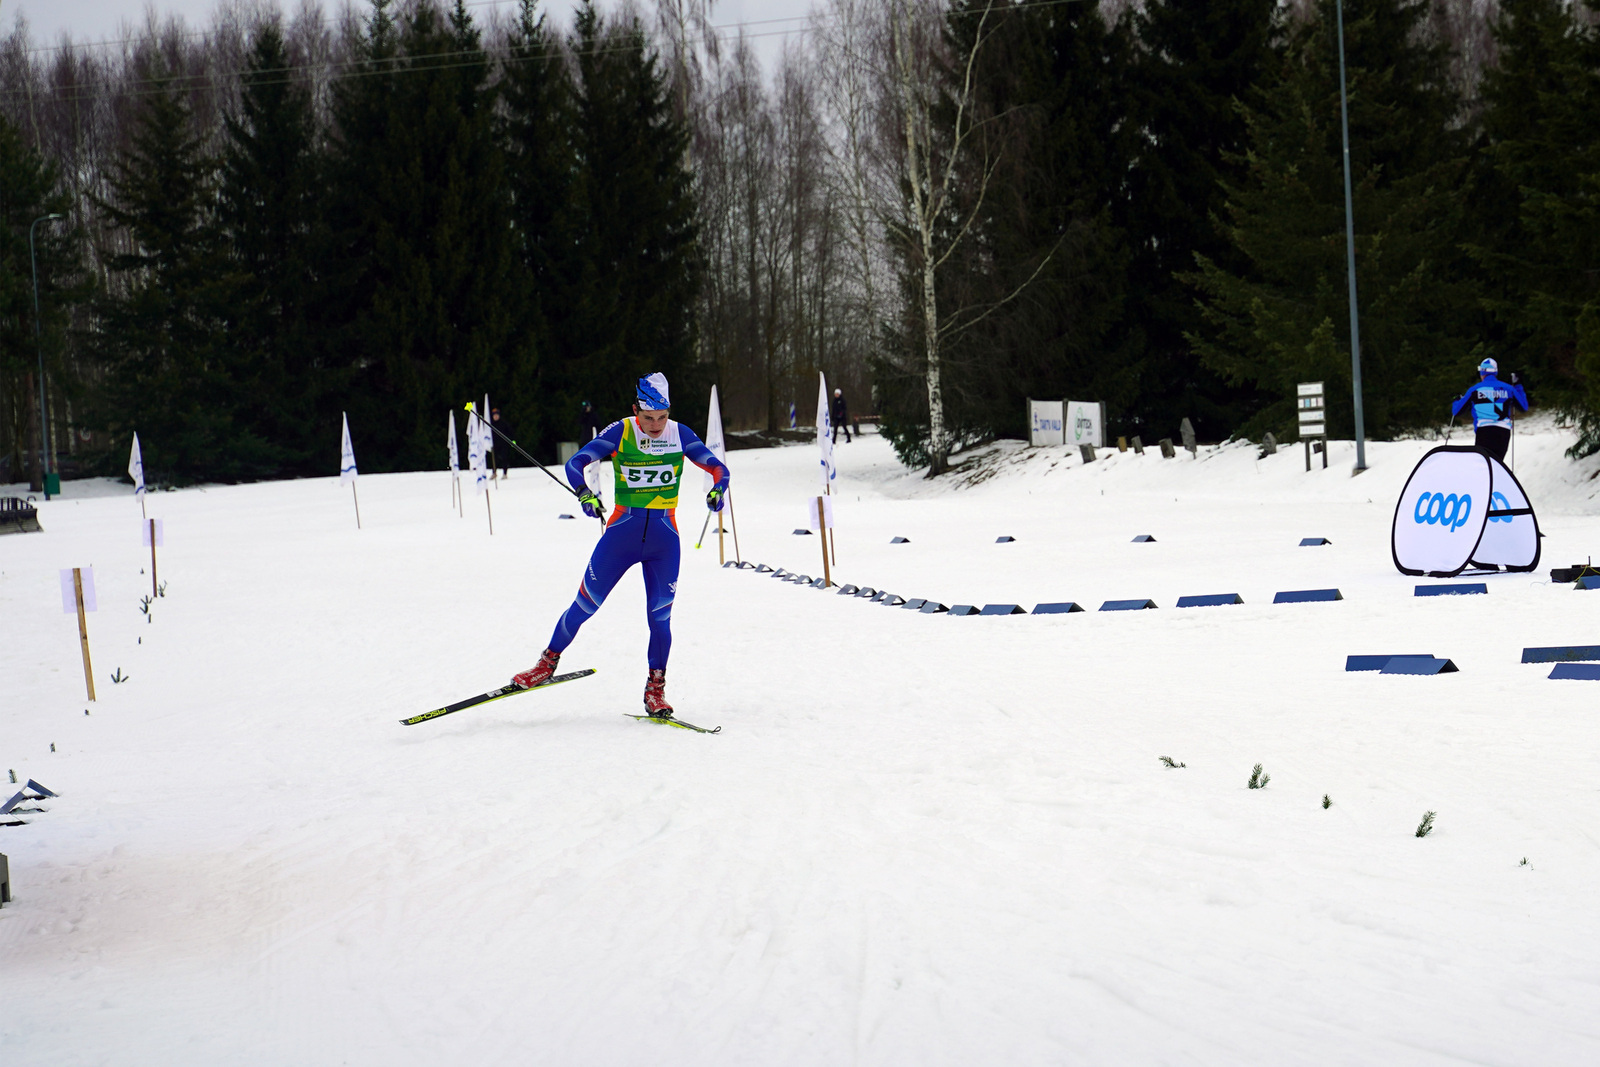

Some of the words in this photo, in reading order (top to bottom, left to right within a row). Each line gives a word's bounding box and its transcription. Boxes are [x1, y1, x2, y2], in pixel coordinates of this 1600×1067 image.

[1477, 389, 1509, 400] ESTONIA
[627, 468, 673, 485] 570
[1414, 491, 1472, 533] coop
[408, 707, 447, 724] FISCHER
